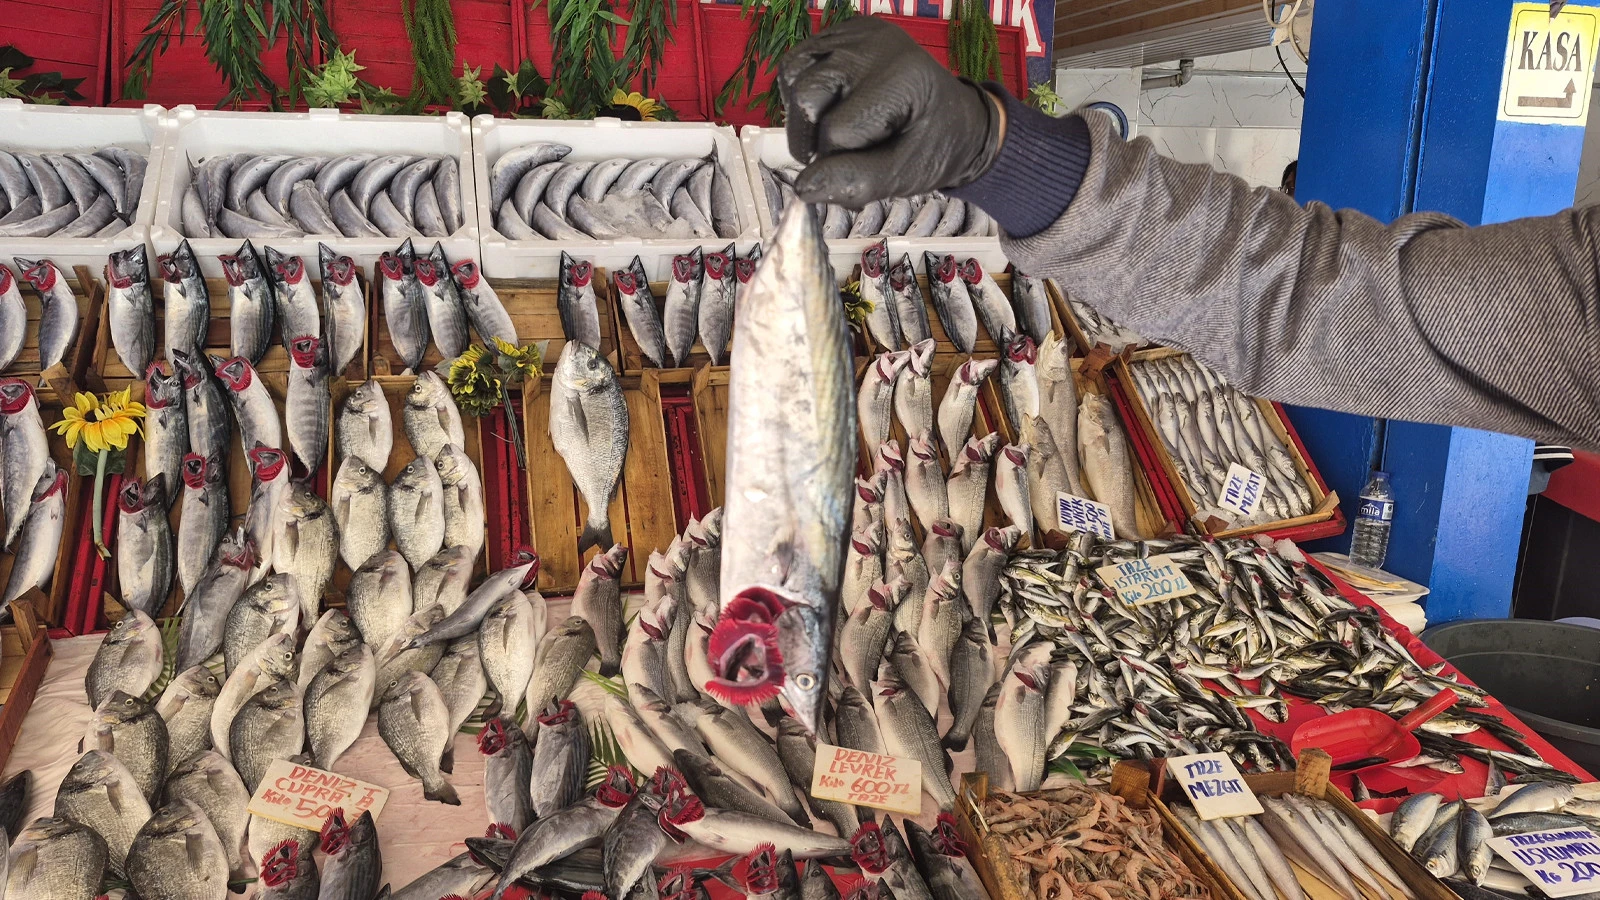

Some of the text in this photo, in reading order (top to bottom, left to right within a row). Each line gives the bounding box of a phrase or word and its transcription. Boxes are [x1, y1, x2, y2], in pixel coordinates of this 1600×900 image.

[1518, 31, 1582, 72] KASA
[1225, 474, 1243, 506] TAZE
[1360, 506, 1380, 516] mila
[1116, 559, 1151, 576] TAZE
[1141, 579, 1172, 600] 200
[829, 760, 897, 781] LEVREK
[1183, 759, 1223, 779] TAZE
[850, 777, 892, 794] 600
[1187, 778, 1244, 800] MEZGIT
[847, 793, 889, 804] TAZE
[1511, 841, 1600, 866] USKUMRU
